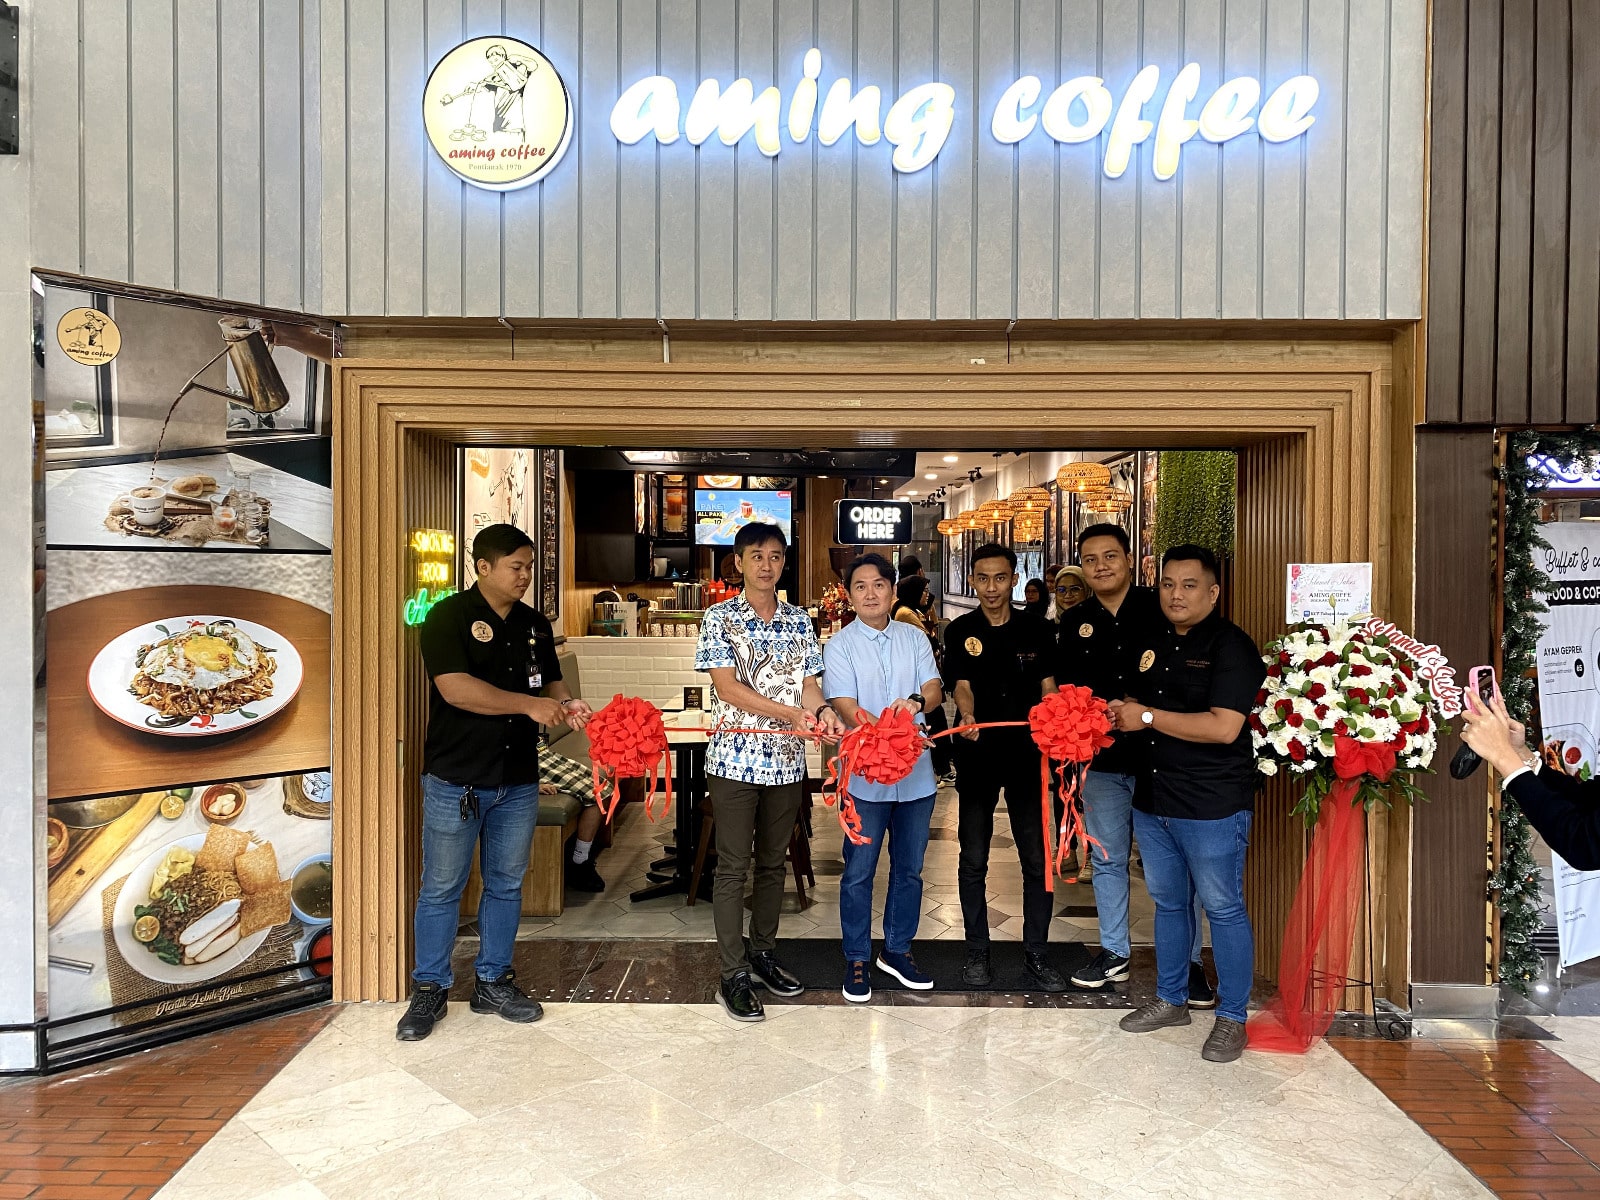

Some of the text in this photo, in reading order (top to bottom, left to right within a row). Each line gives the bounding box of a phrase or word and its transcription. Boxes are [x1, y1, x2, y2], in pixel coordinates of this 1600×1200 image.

[609, 47, 1320, 181] aming coffee
[449, 144, 546, 162] aming coffee
[850, 506, 902, 523] ORDER
[857, 523, 895, 539] HERE
[414, 531, 455, 554] SMOKING
[1545, 547, 1579, 574] Buffet
[422, 562, 449, 582] ROOM
[1543, 647, 1560, 657] AYAM
